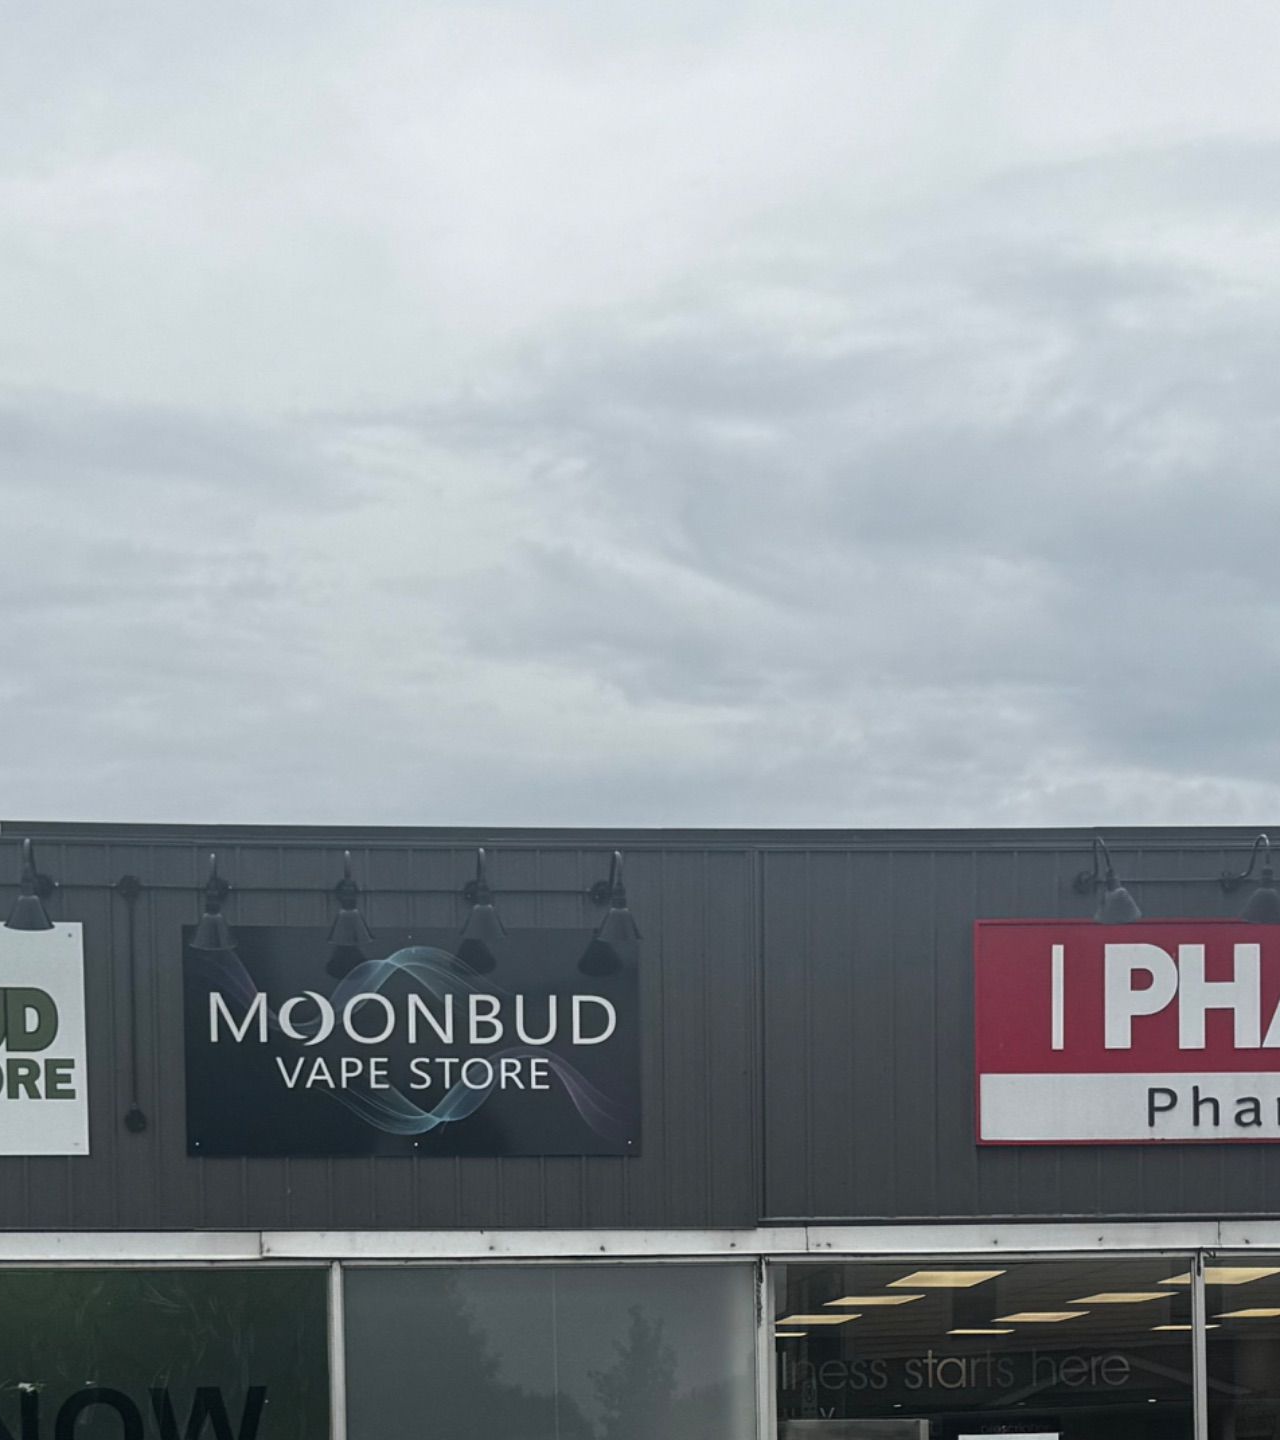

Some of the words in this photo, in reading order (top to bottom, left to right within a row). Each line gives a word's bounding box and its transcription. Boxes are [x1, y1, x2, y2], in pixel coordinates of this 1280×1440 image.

[210, 990, 616, 1045] MOONBUD
[275, 1056, 389, 1090] VAPE
[408, 1056, 550, 1090] STORE
[905, 1349, 1013, 1389] starts
[1033, 1349, 1131, 1388] here
